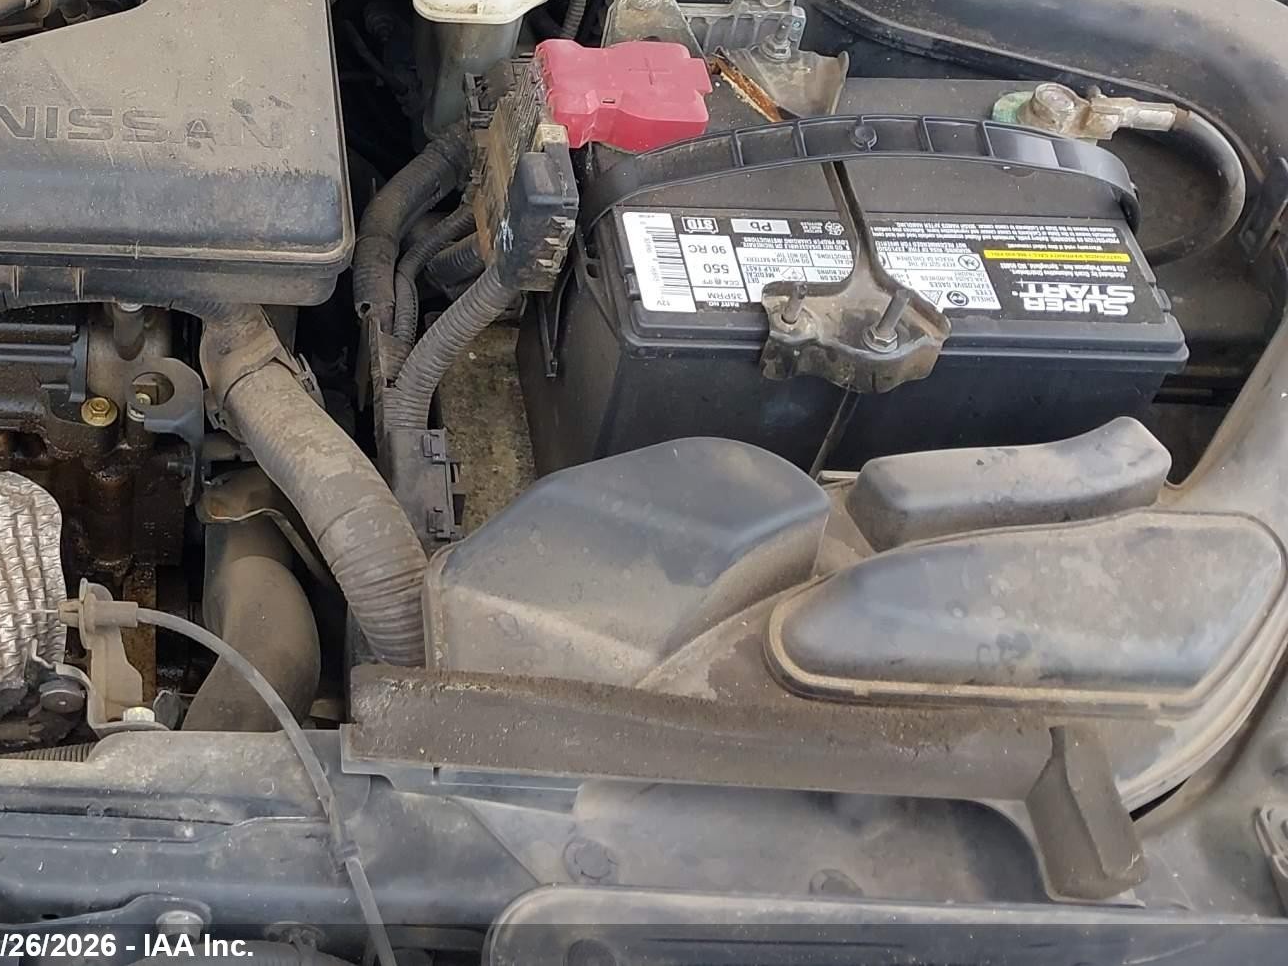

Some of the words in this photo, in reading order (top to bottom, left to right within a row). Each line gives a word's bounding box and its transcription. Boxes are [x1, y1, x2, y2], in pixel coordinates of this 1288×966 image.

[687, 220, 714, 230] STD
[750, 222, 772, 232] Pb
[687, 244, 708, 254] RC
[712, 245, 727, 254] 90
[704, 264, 730, 274] 550
[1019, 284, 1136, 304] START
[1023, 297, 1128, 316] SUPER
